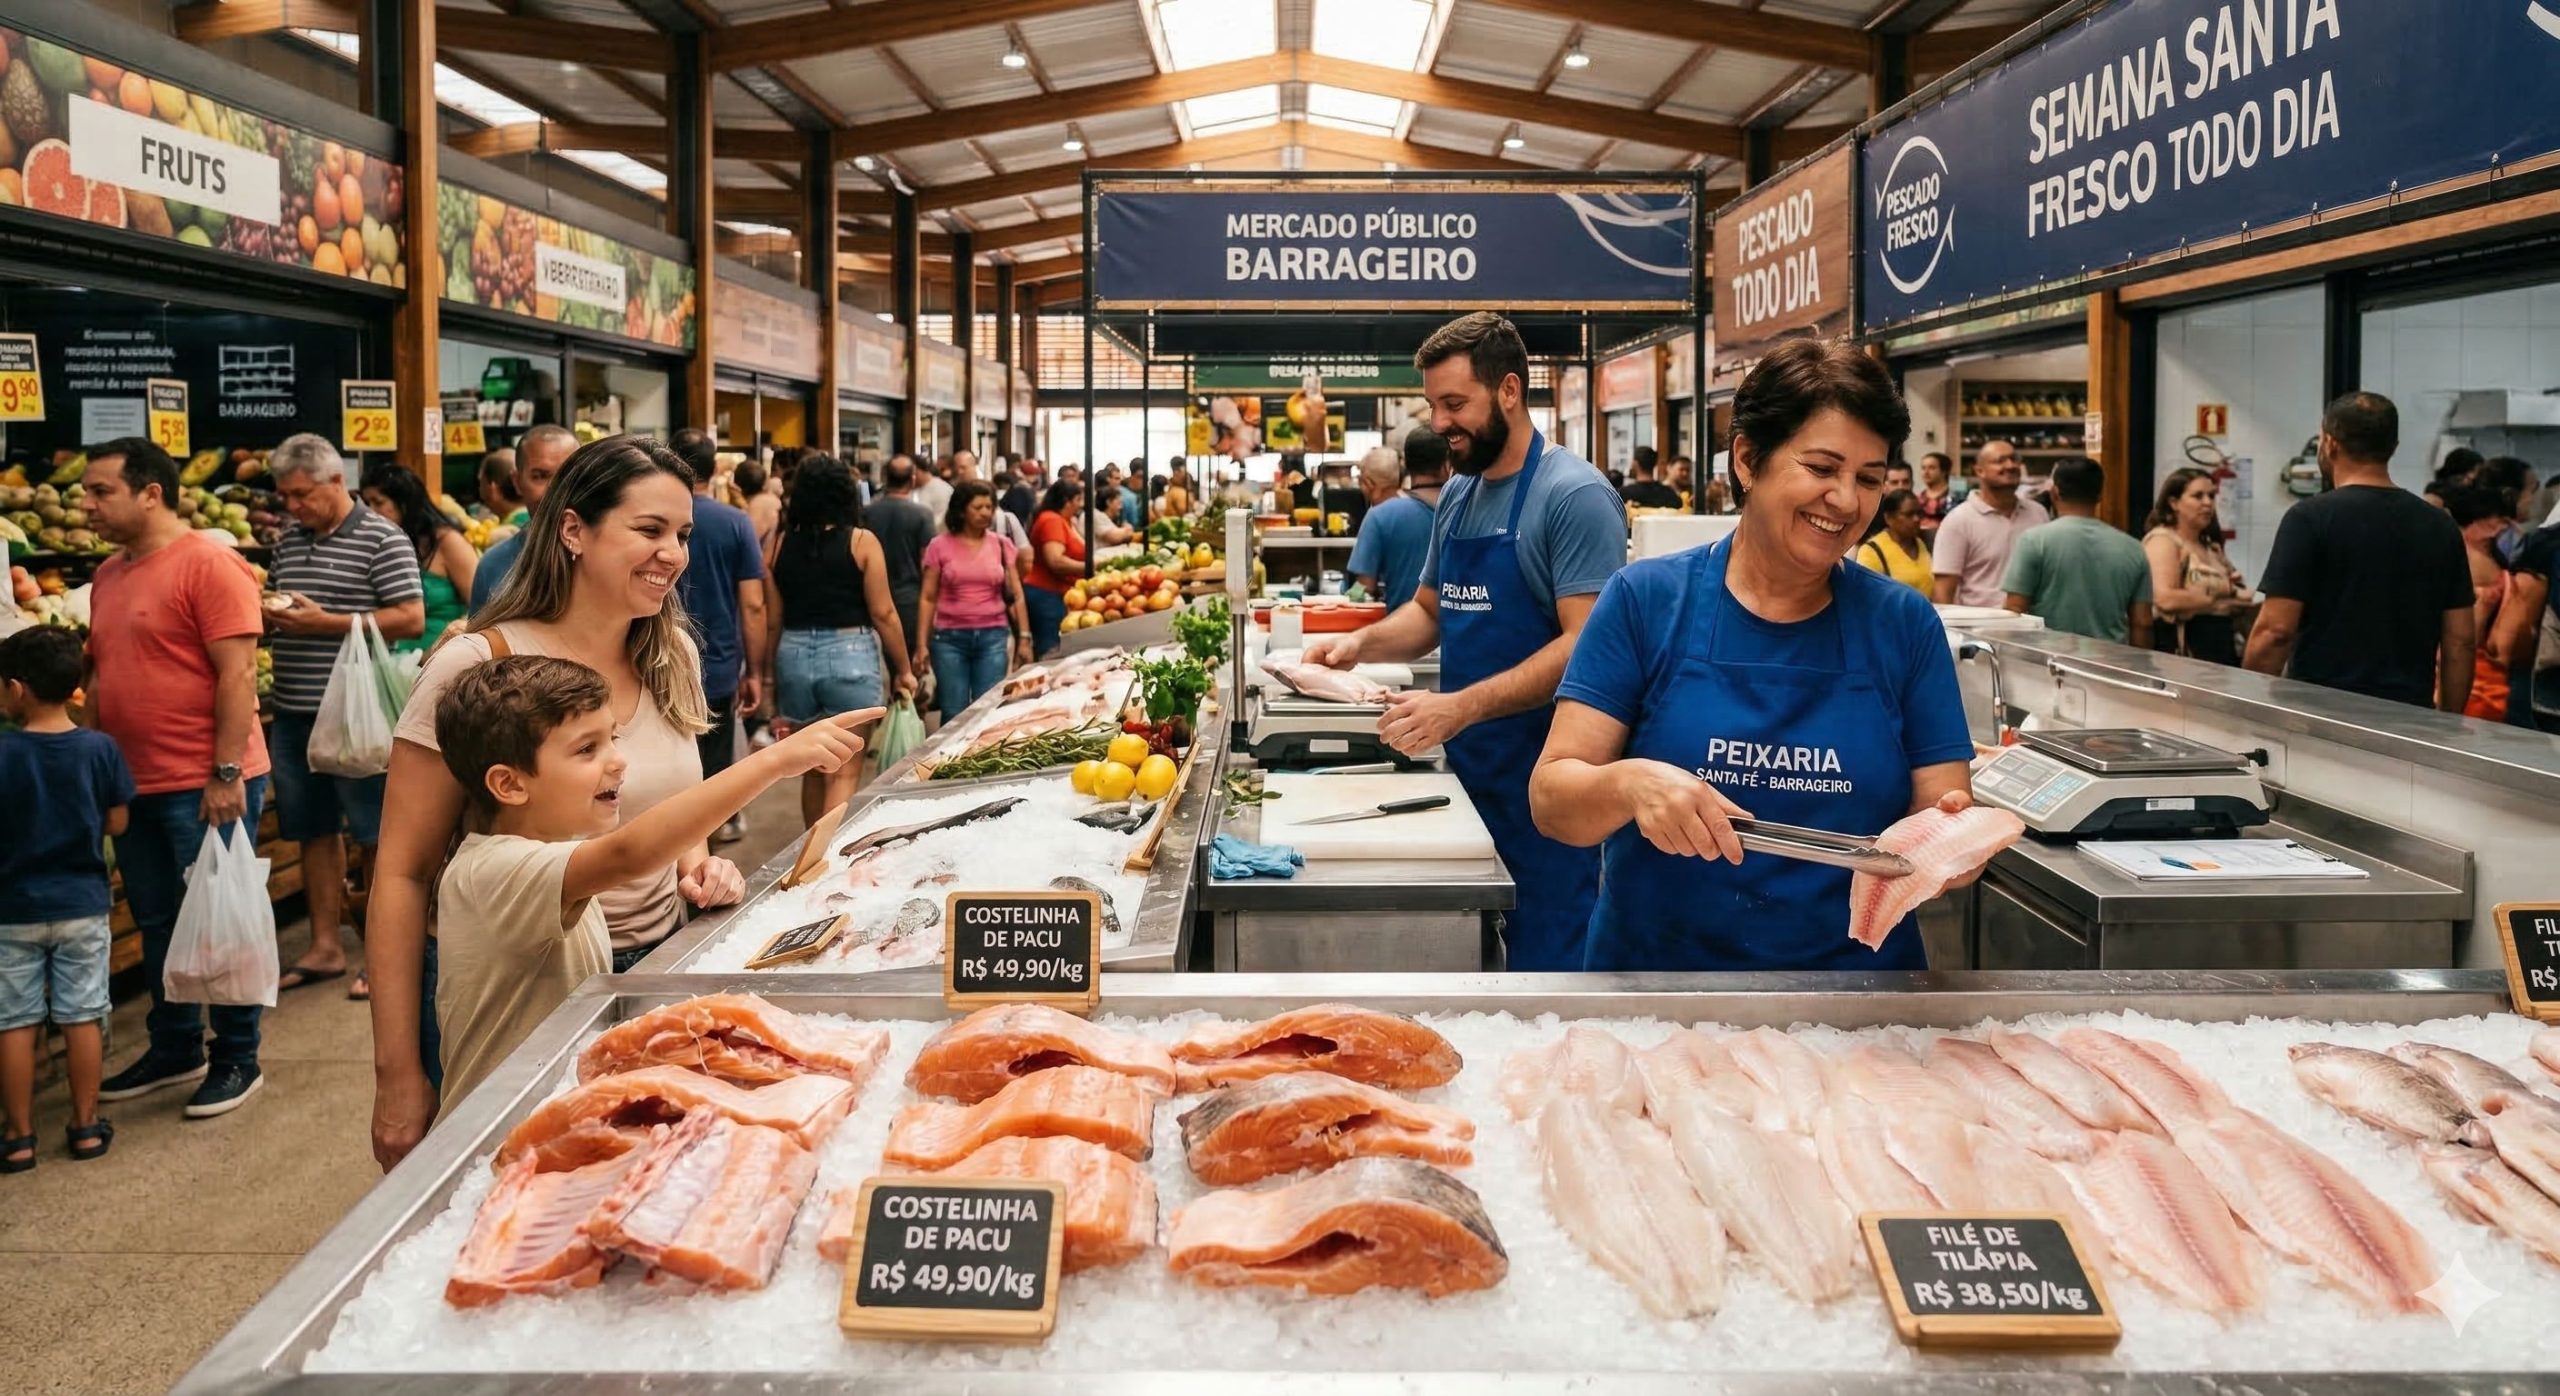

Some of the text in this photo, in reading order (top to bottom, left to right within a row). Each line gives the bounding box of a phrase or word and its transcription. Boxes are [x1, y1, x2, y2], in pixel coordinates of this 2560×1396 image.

[2029, 37, 2175, 164] SEMANA
[141, 136, 226, 194] FRUTS
[2029, 70, 2340, 238] FRESCO TODO DIA
[1886, 172, 1940, 219] PESCADO
[1226, 206, 1477, 239] MERCADO PÚBLICO
[1739, 189, 1814, 265] PESCADO
[1887, 206, 1939, 252] FRESCO
[1226, 247, 1477, 281] BARRAGEIRO
[1732, 246, 1821, 328] TODO DIA
[1442, 582, 1490, 600] PEIXARIA
[1707, 738, 1842, 773] PEIXARIA
[1696, 767, 1739, 785] SANTA
[1742, 771, 1759, 787] FÉ
[1769, 776, 1853, 793] BARRAGEIRO
[965, 906, 1081, 924] COSTELINHA
[983, 930, 1062, 948] DE PACU
[962, 956, 1084, 983] R$ 49,90/kg
[2530, 965, 2558, 991] R$
[884, 1196, 1039, 1222] COSTELINHA
[904, 1226, 1012, 1252] DE PACU
[1926, 1222, 2021, 1246] FILÉ DE
[1931, 1247, 2038, 1271] TILÁPIA
[870, 1259, 1037, 1299] R$ 49,90/kg
[1913, 1279, 2088, 1311] R$ 38,50/kg
